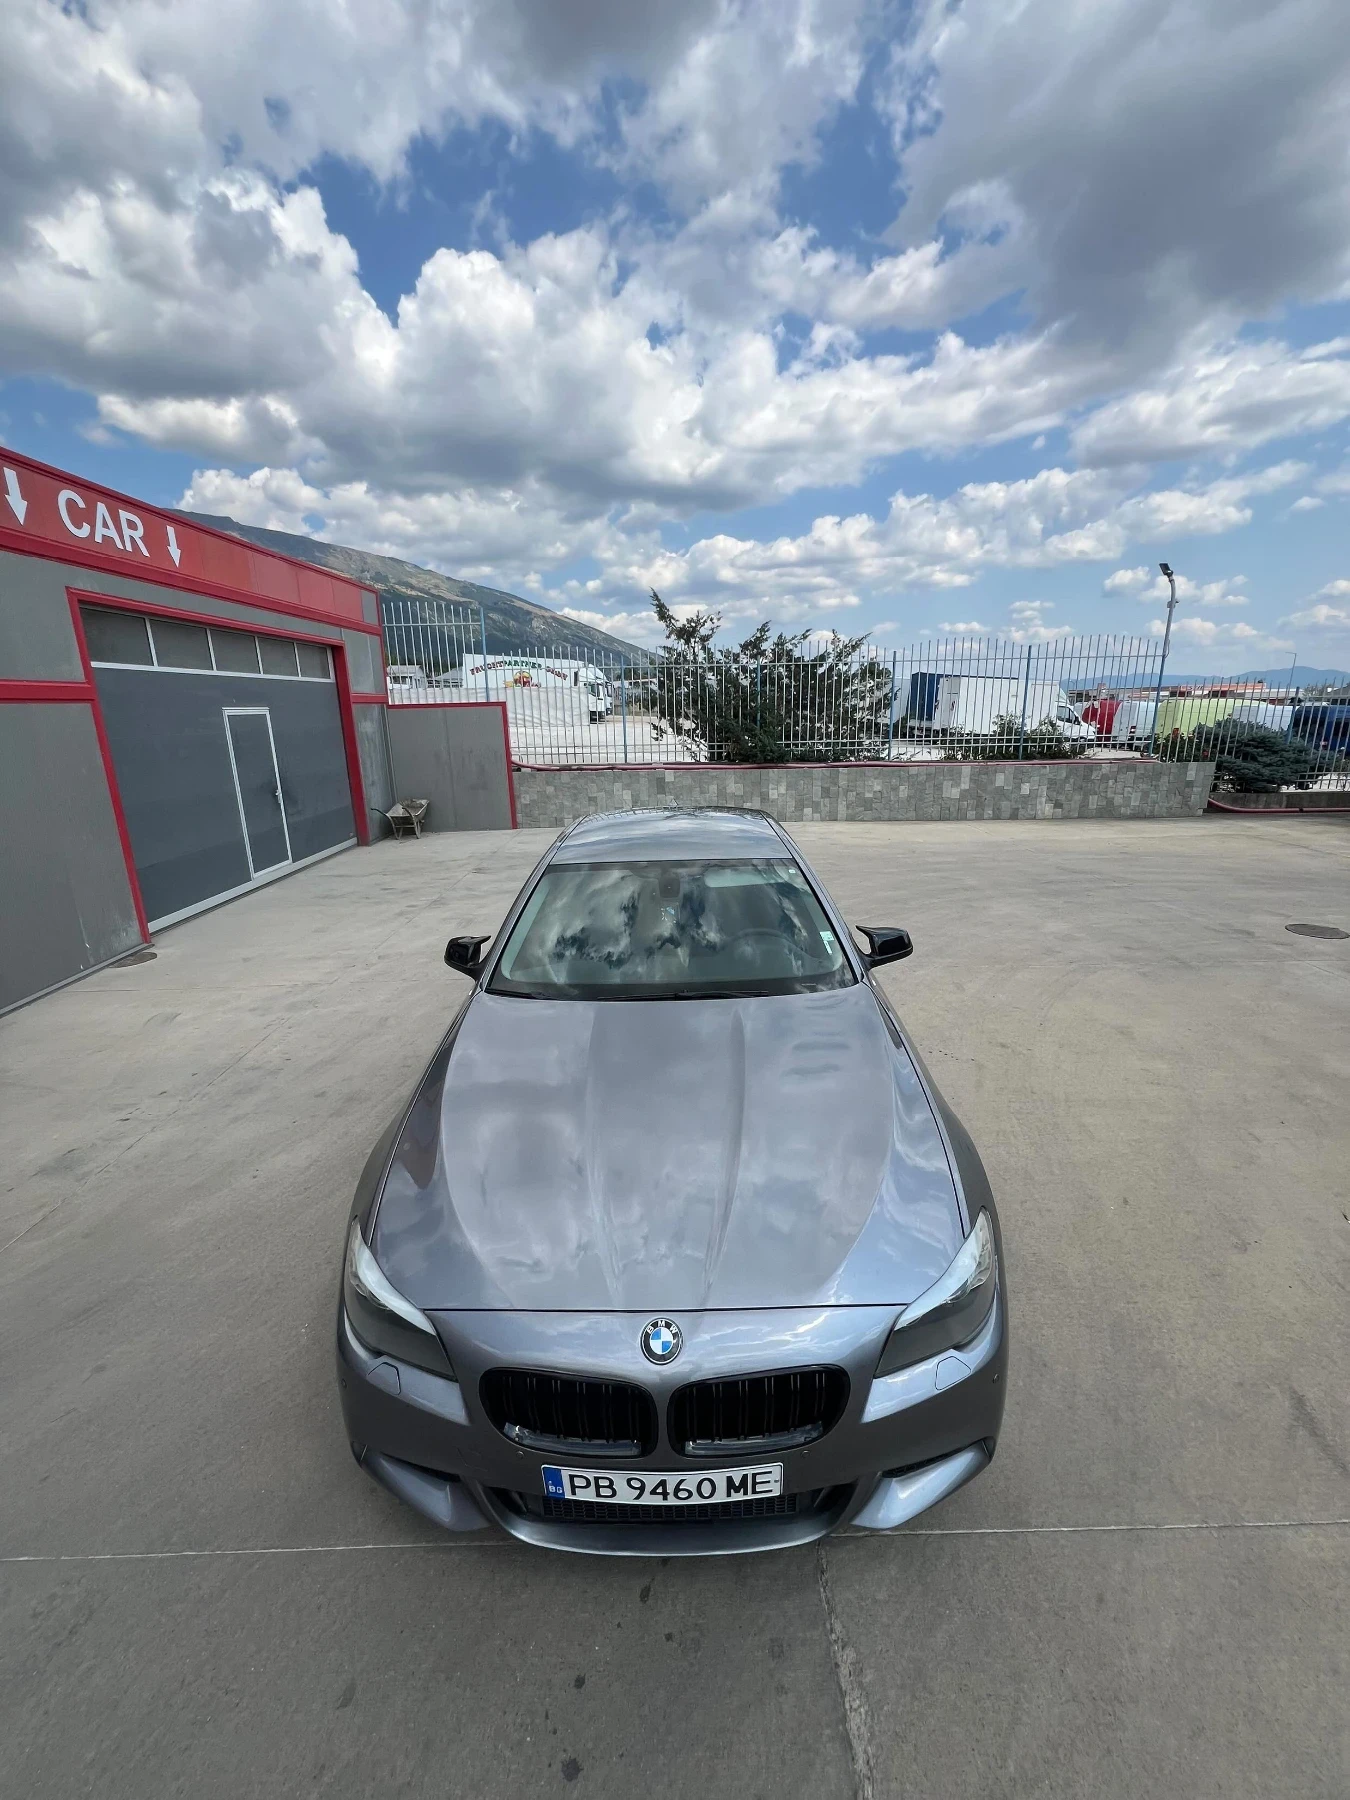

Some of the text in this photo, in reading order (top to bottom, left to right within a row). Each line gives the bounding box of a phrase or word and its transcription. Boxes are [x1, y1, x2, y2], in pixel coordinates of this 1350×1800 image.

[57, 489, 151, 558] CAR
[646, 1319, 679, 1334] BMW
[548, 1485, 563, 1494] BG
[568, 1470, 773, 1501] PB 9460 ME
